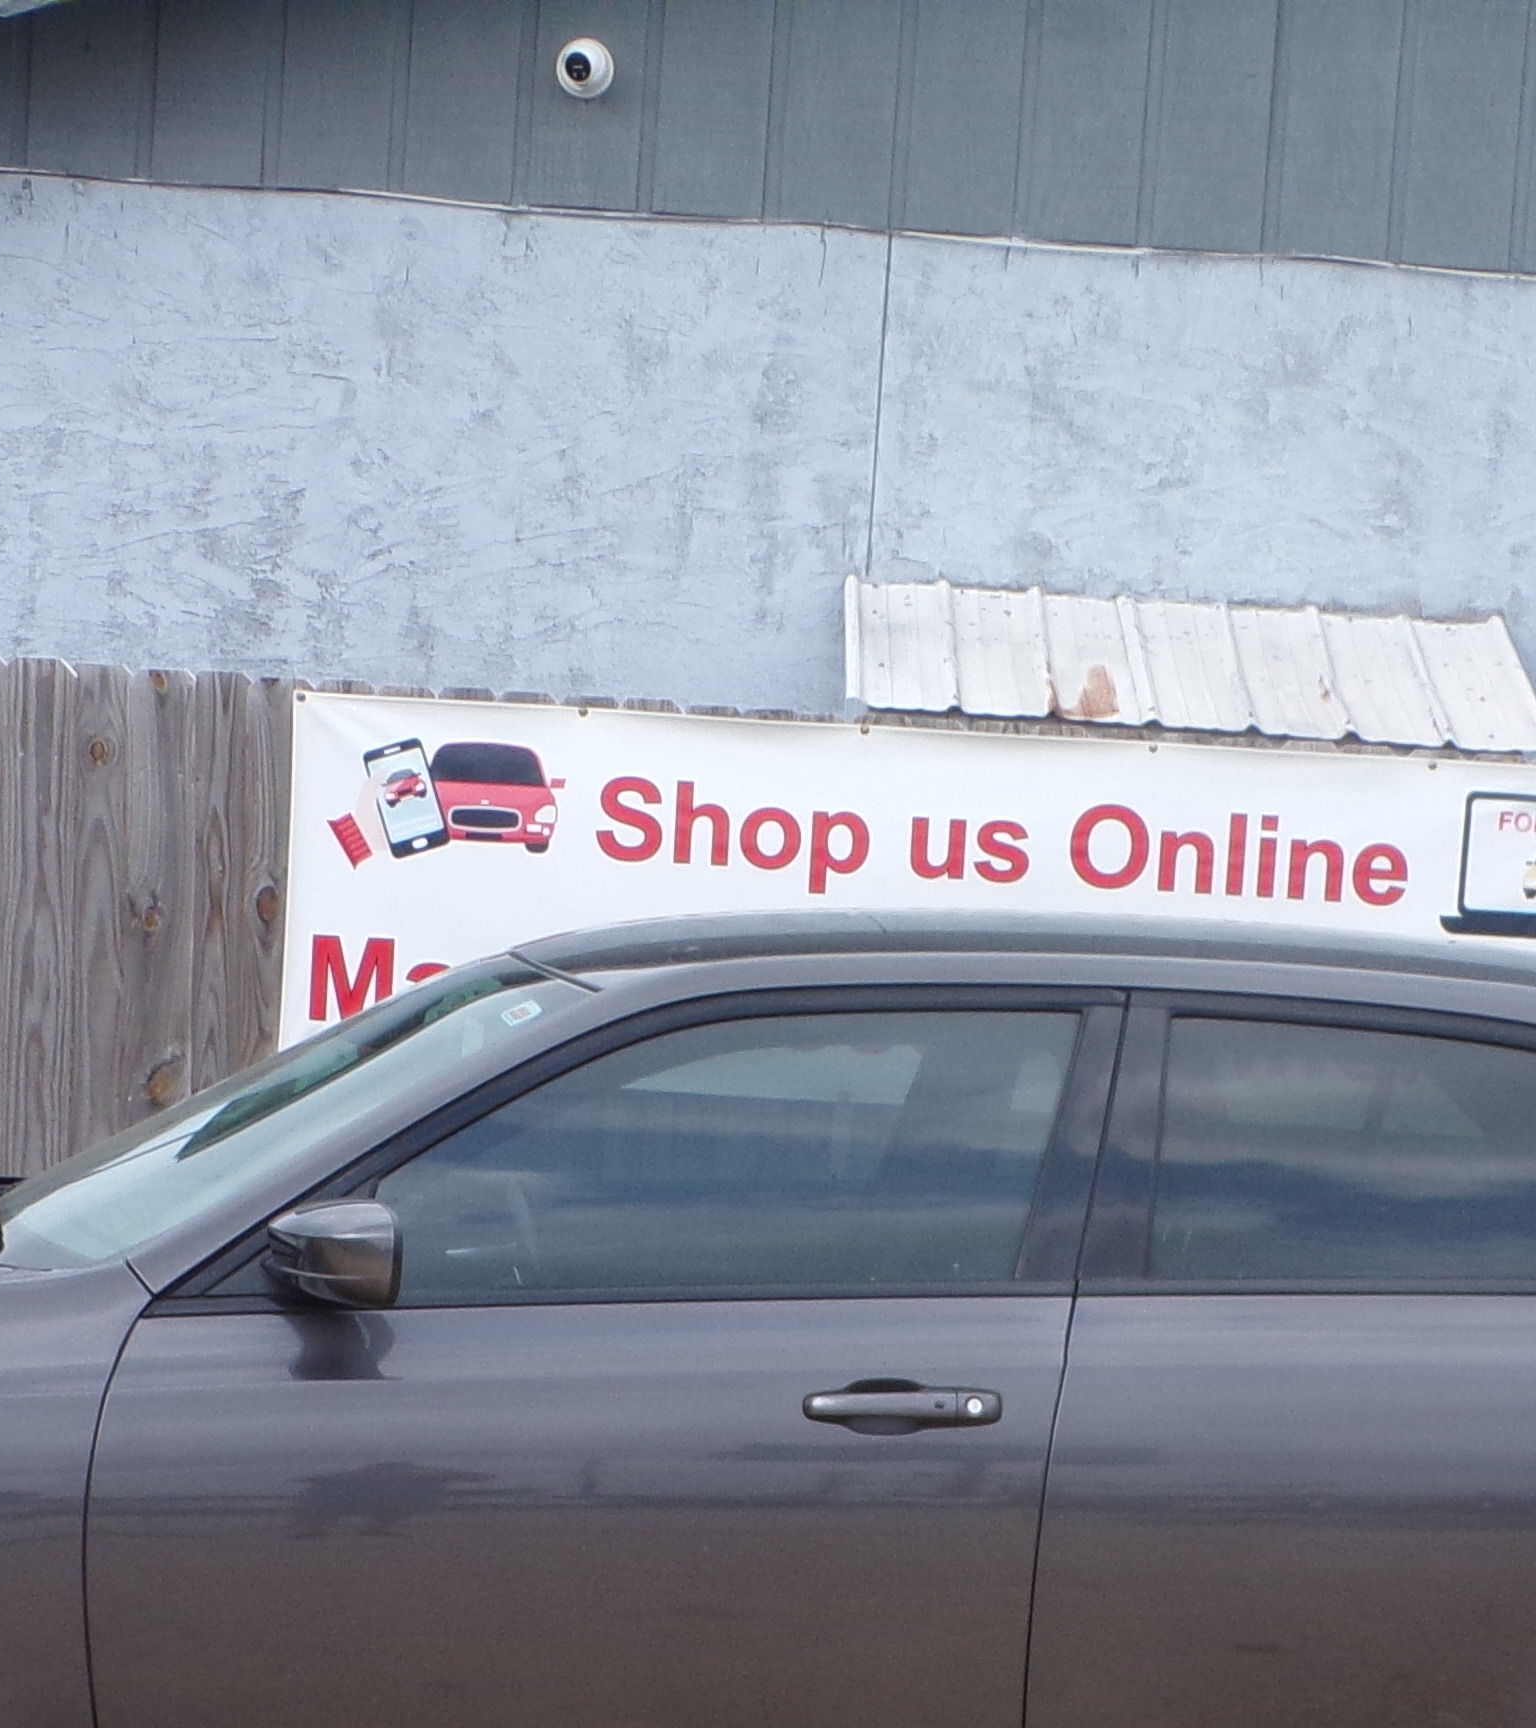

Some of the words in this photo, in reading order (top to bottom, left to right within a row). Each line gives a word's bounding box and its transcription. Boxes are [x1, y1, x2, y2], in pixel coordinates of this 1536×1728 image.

[596, 776, 870, 895] Shop
[910, 816, 1030, 884] us
[1070, 803, 1409, 906] Online
[309, 933, 453, 1021] M
